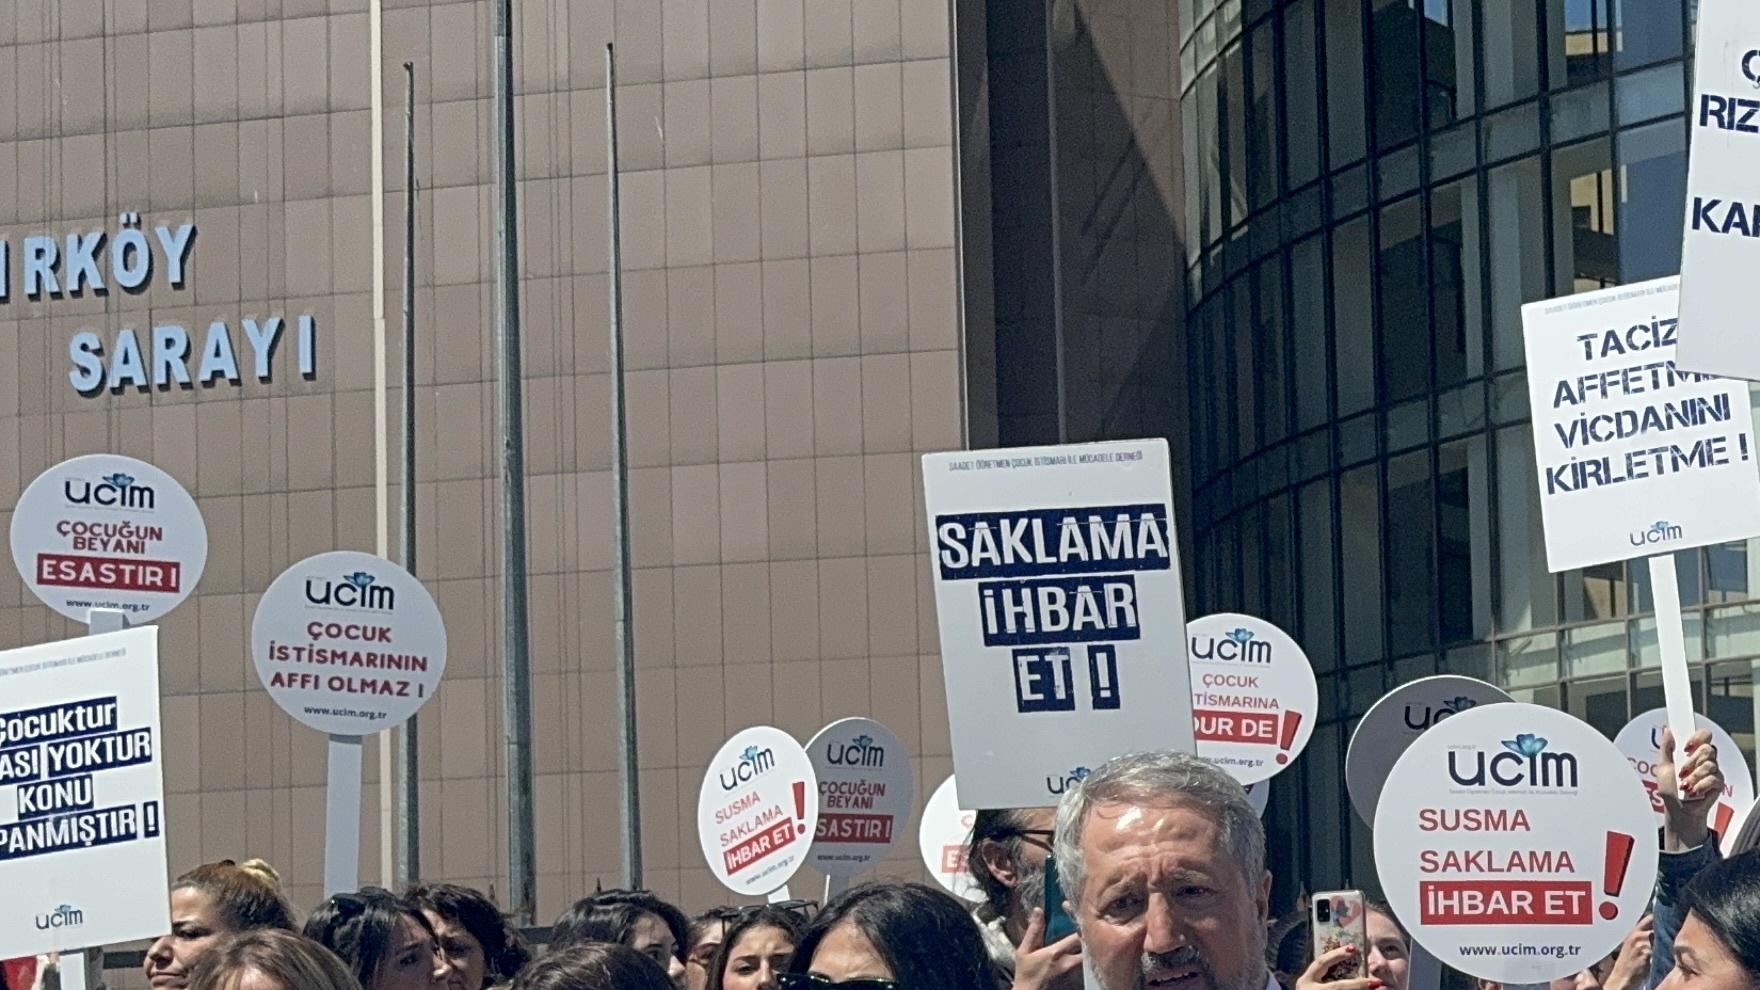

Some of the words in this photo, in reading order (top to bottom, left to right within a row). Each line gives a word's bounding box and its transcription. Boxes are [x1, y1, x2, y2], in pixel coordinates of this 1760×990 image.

[1577, 315, 1679, 361] TACİZ
[69, 314, 315, 394] SARAYI
[1553, 360, 1719, 409] AFFETM
[1554, 392, 1731, 449] VİCDANINI
[1546, 436, 1730, 496] KİRLETME
[65, 480, 154, 509] ucim
[57, 520, 163, 541] ÇOCUĞUN
[73, 536, 145, 554] BEYANI
[940, 512, 1168, 568] SAKLAMA
[1630, 525, 1683, 546] ucim
[42, 559, 163, 587] ESASTIR
[305, 579, 395, 610] ucim
[984, 582, 1135, 634] İHBAR
[307, 621, 392, 643] ÇOCUK
[269, 640, 427, 672] İSTİSMARININ
[1191, 636, 1272, 664] ucim
[271, 672, 319, 690] AFFI
[328, 676, 411, 697] OLMAZ
[1018, 654, 1070, 701] ET
[1202, 673, 1259, 689] ÇOCUK
[304, 706, 387, 720] www.ucim.org.tr
[1194, 691, 1279, 709] TİSMARINA
[1194, 717, 1234, 736] UR
[1241, 719, 1274, 739] DE
[0, 748, 39, 780] ASI
[48, 731, 151, 772] YOKTUR
[720, 748, 775, 791] ucim
[827, 743, 884, 767] ucim
[1448, 751, 1578, 788] ucim
[18, 777, 92, 814] KONU
[819, 780, 886, 797] ÇOCUĞUN
[827, 795, 873, 809] BEYANI
[715, 791, 761, 825] SUSMA
[1418, 807, 1531, 833] SUSMA
[0, 808, 136, 854] ANMIŞTIR
[720, 805, 783, 847] SAKLAMA
[816, 818, 882, 838] SASTIR
[726, 838, 771, 870] İHBAR
[773, 823, 791, 846] ET
[1419, 849, 1575, 874] SAKLAMA
[1427, 886, 1535, 916] İHBAR
[1545, 890, 1586, 916] ET
[35, 909, 84, 930] ucim
[1459, 943, 1581, 960] www.ucim.org.tr
